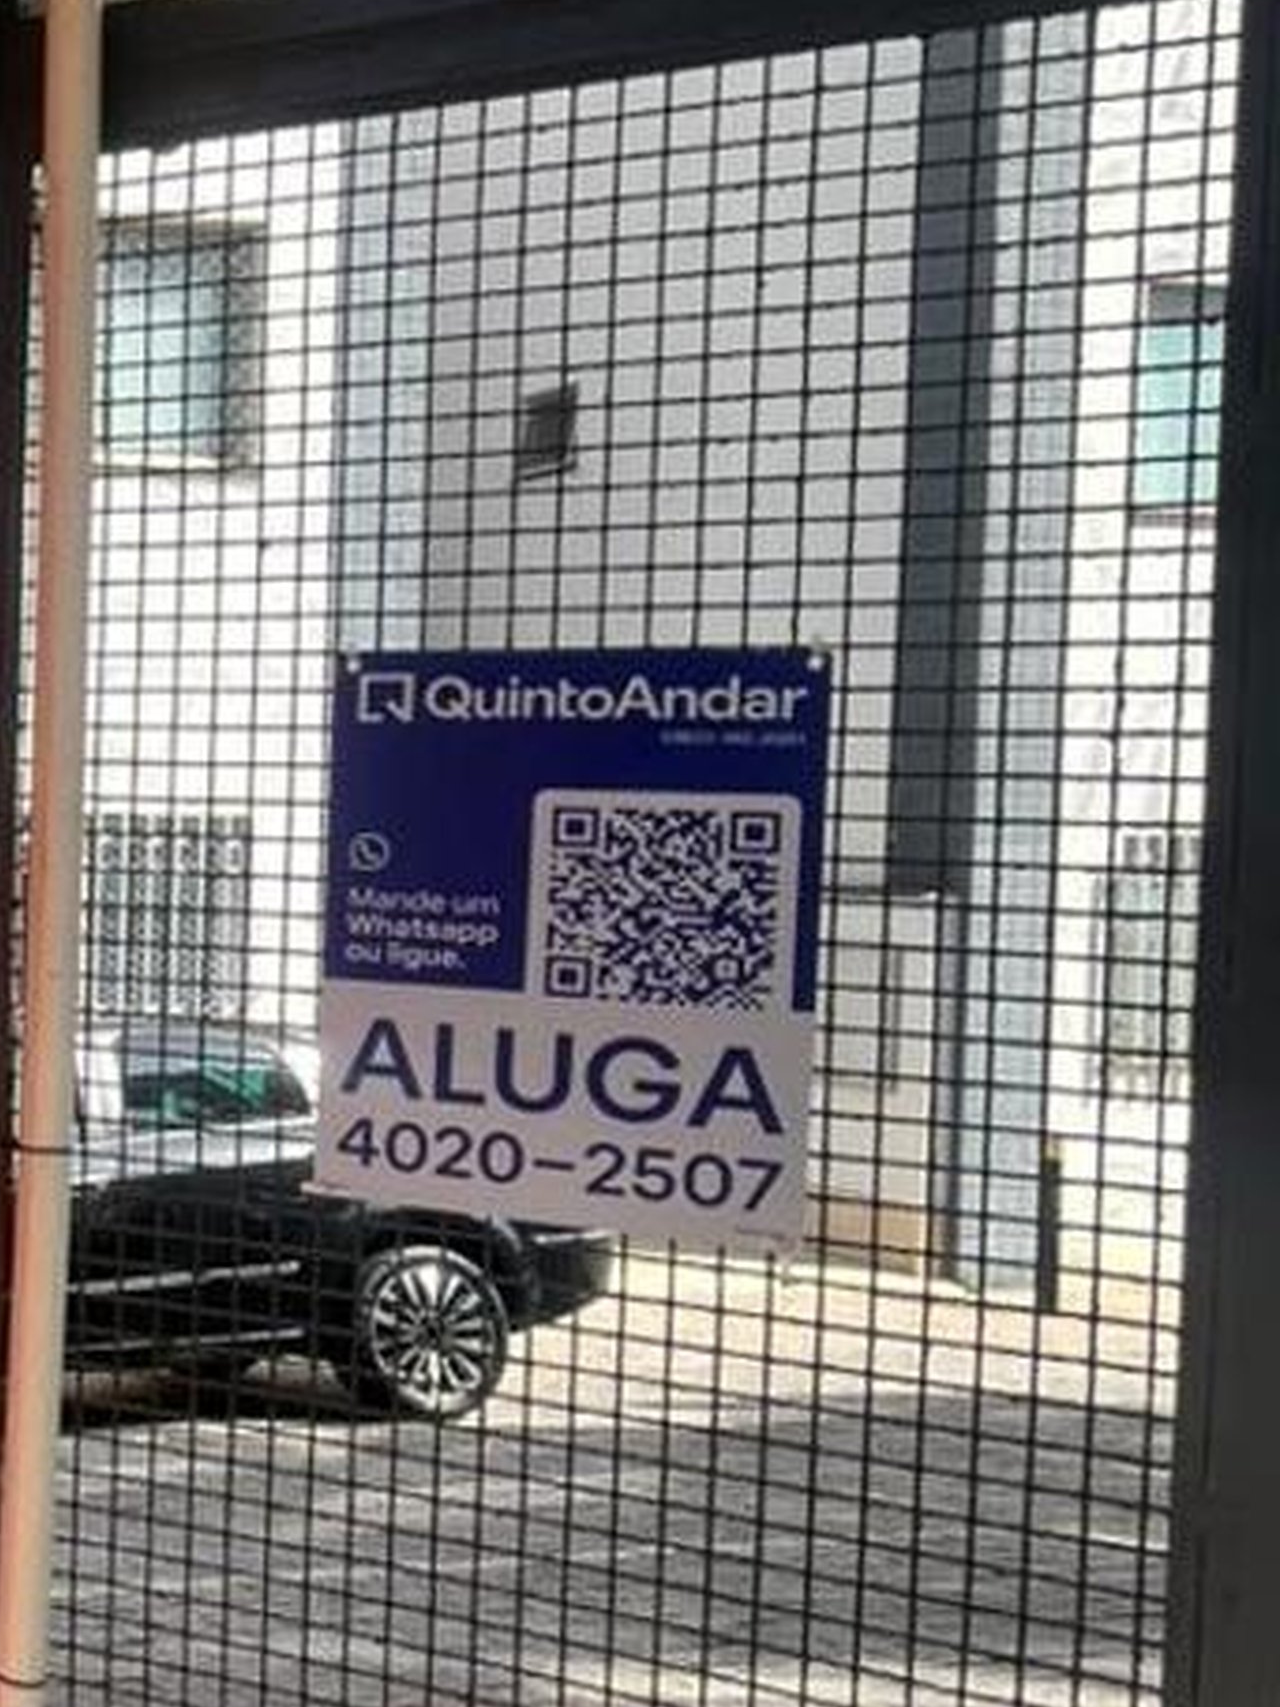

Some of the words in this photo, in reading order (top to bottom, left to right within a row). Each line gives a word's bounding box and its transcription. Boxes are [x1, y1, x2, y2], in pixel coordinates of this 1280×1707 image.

[424, 673, 808, 722] QuintoAndar
[348, 887, 446, 916] Mande
[451, 894, 501, 916] um
[344, 942, 381, 963] ou
[342, 1017, 785, 1136] ALUGA
[336, 1117, 784, 1213] 4020-2507
